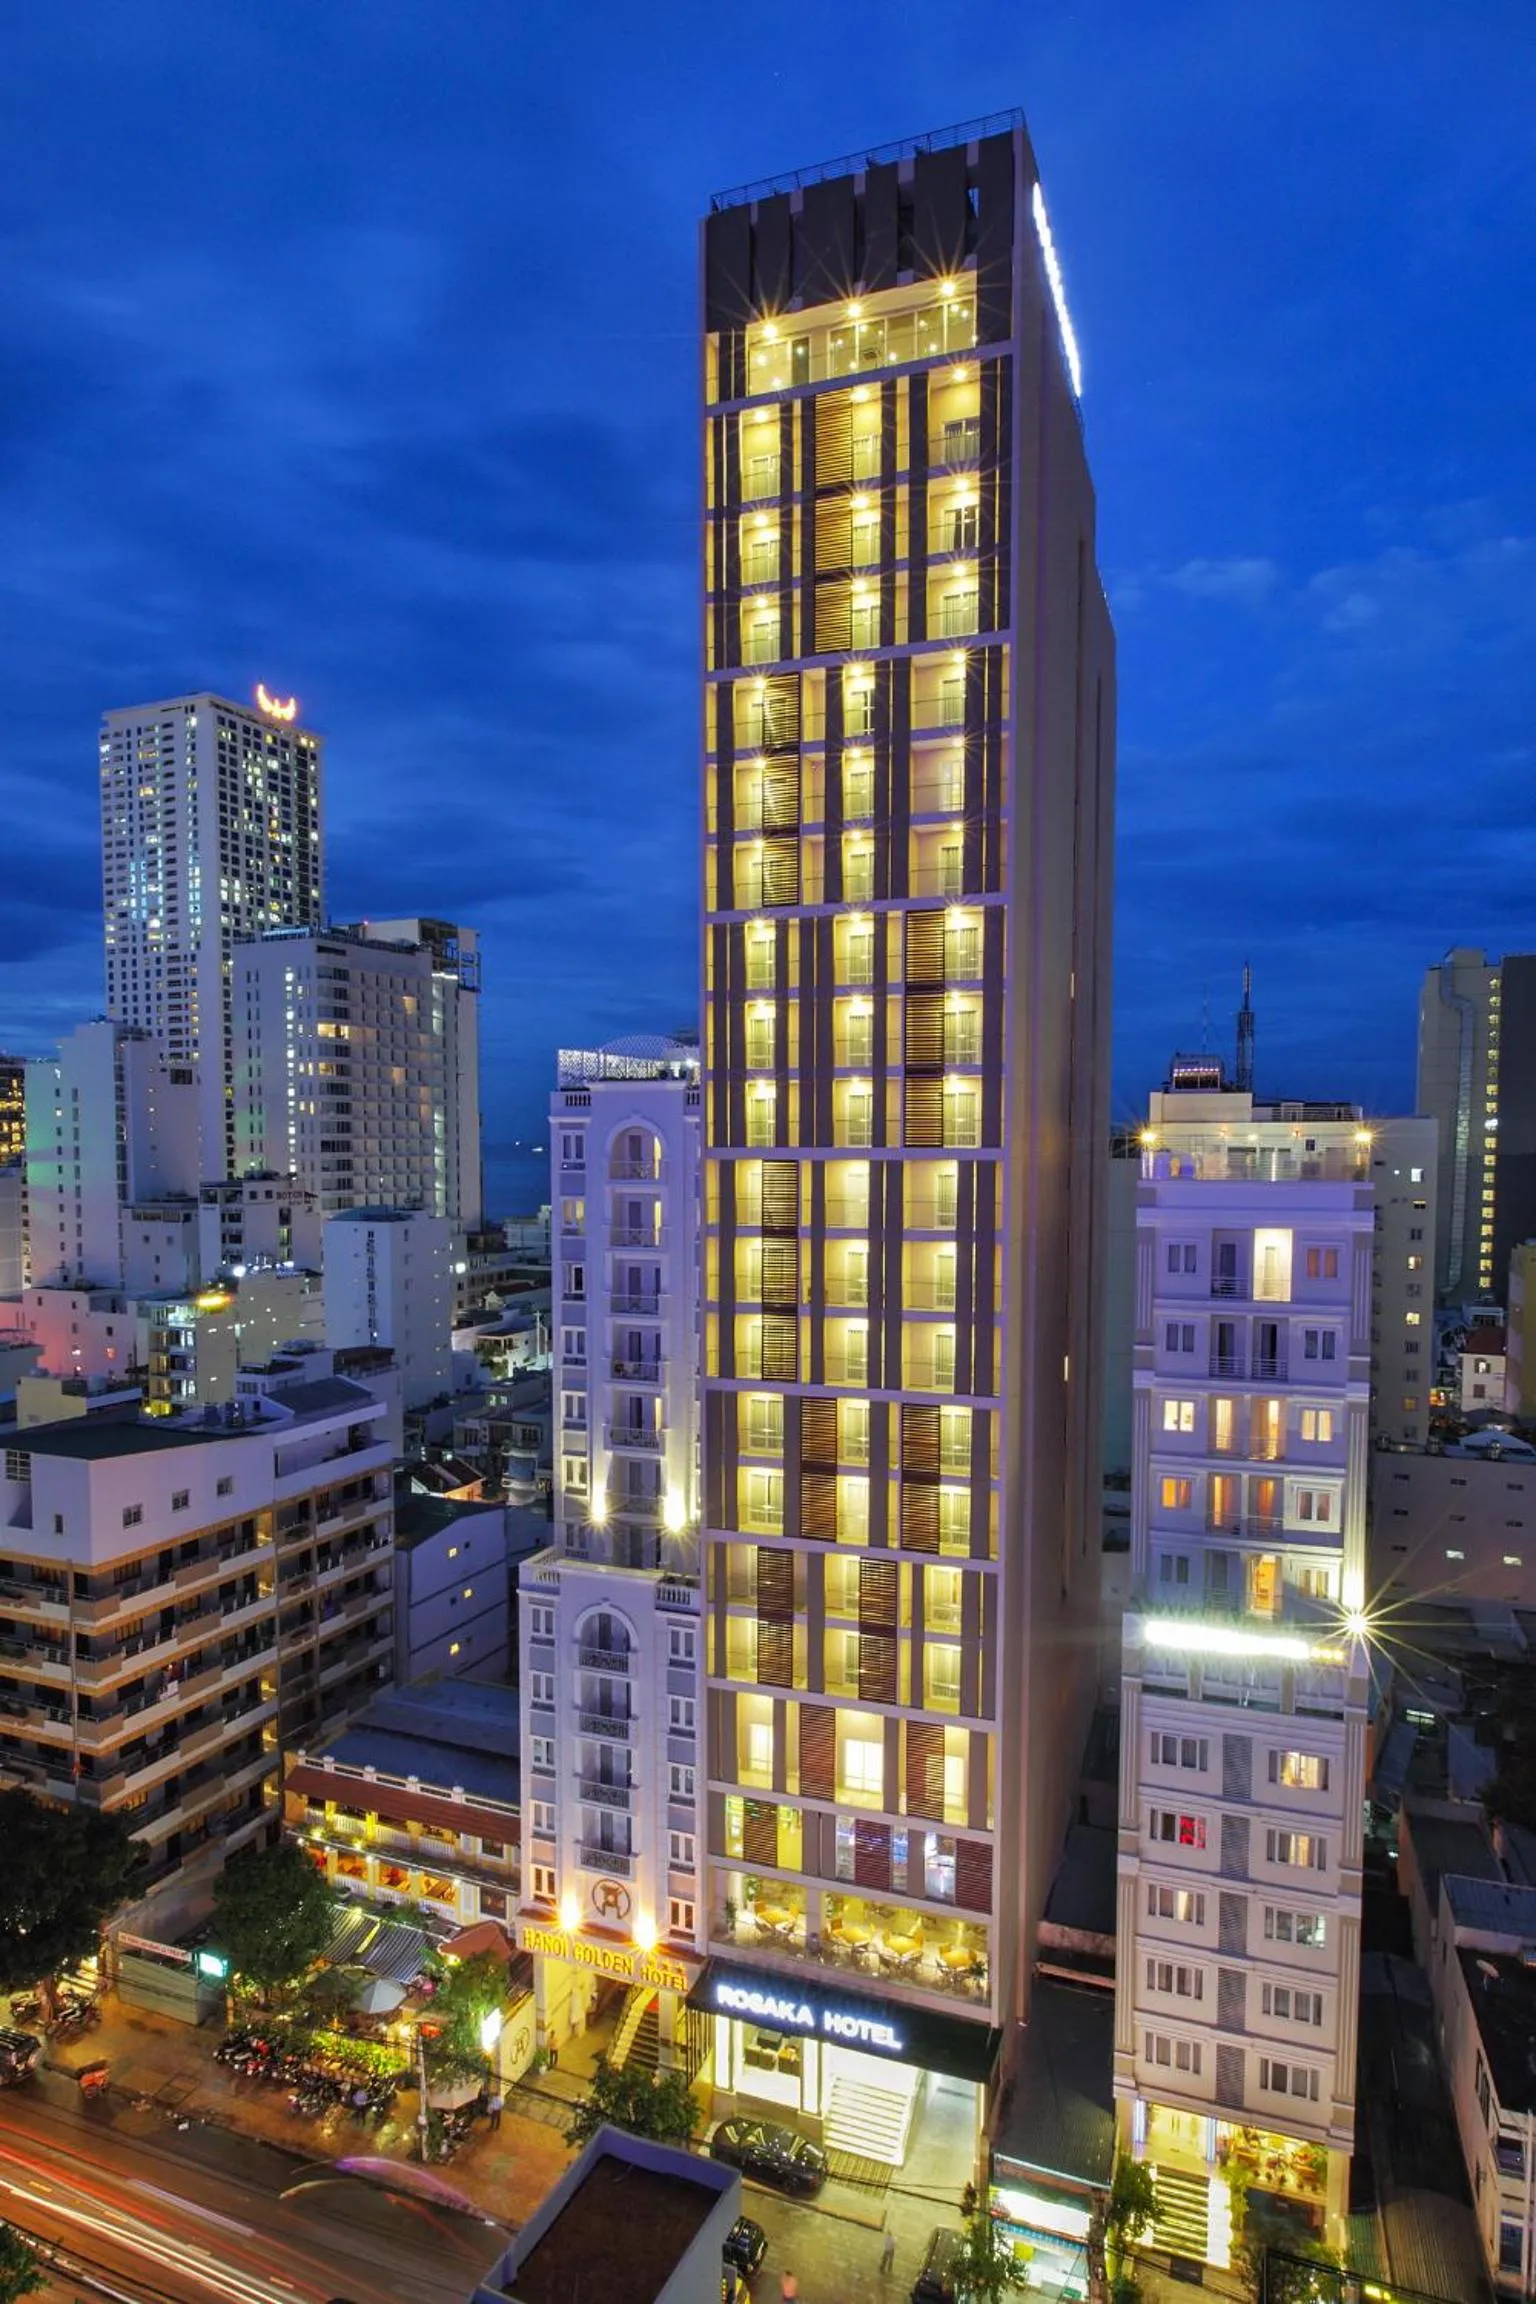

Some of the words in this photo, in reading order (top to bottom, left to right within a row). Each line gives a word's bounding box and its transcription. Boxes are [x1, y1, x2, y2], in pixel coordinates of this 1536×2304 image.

[523, 1927, 569, 1957] HANOI
[573, 1942, 634, 1976] GOLDEN
[640, 1964, 689, 1992] HOTEL
[716, 1984, 814, 2027] ROSAKA
[823, 2010, 903, 2050] HOTEL
